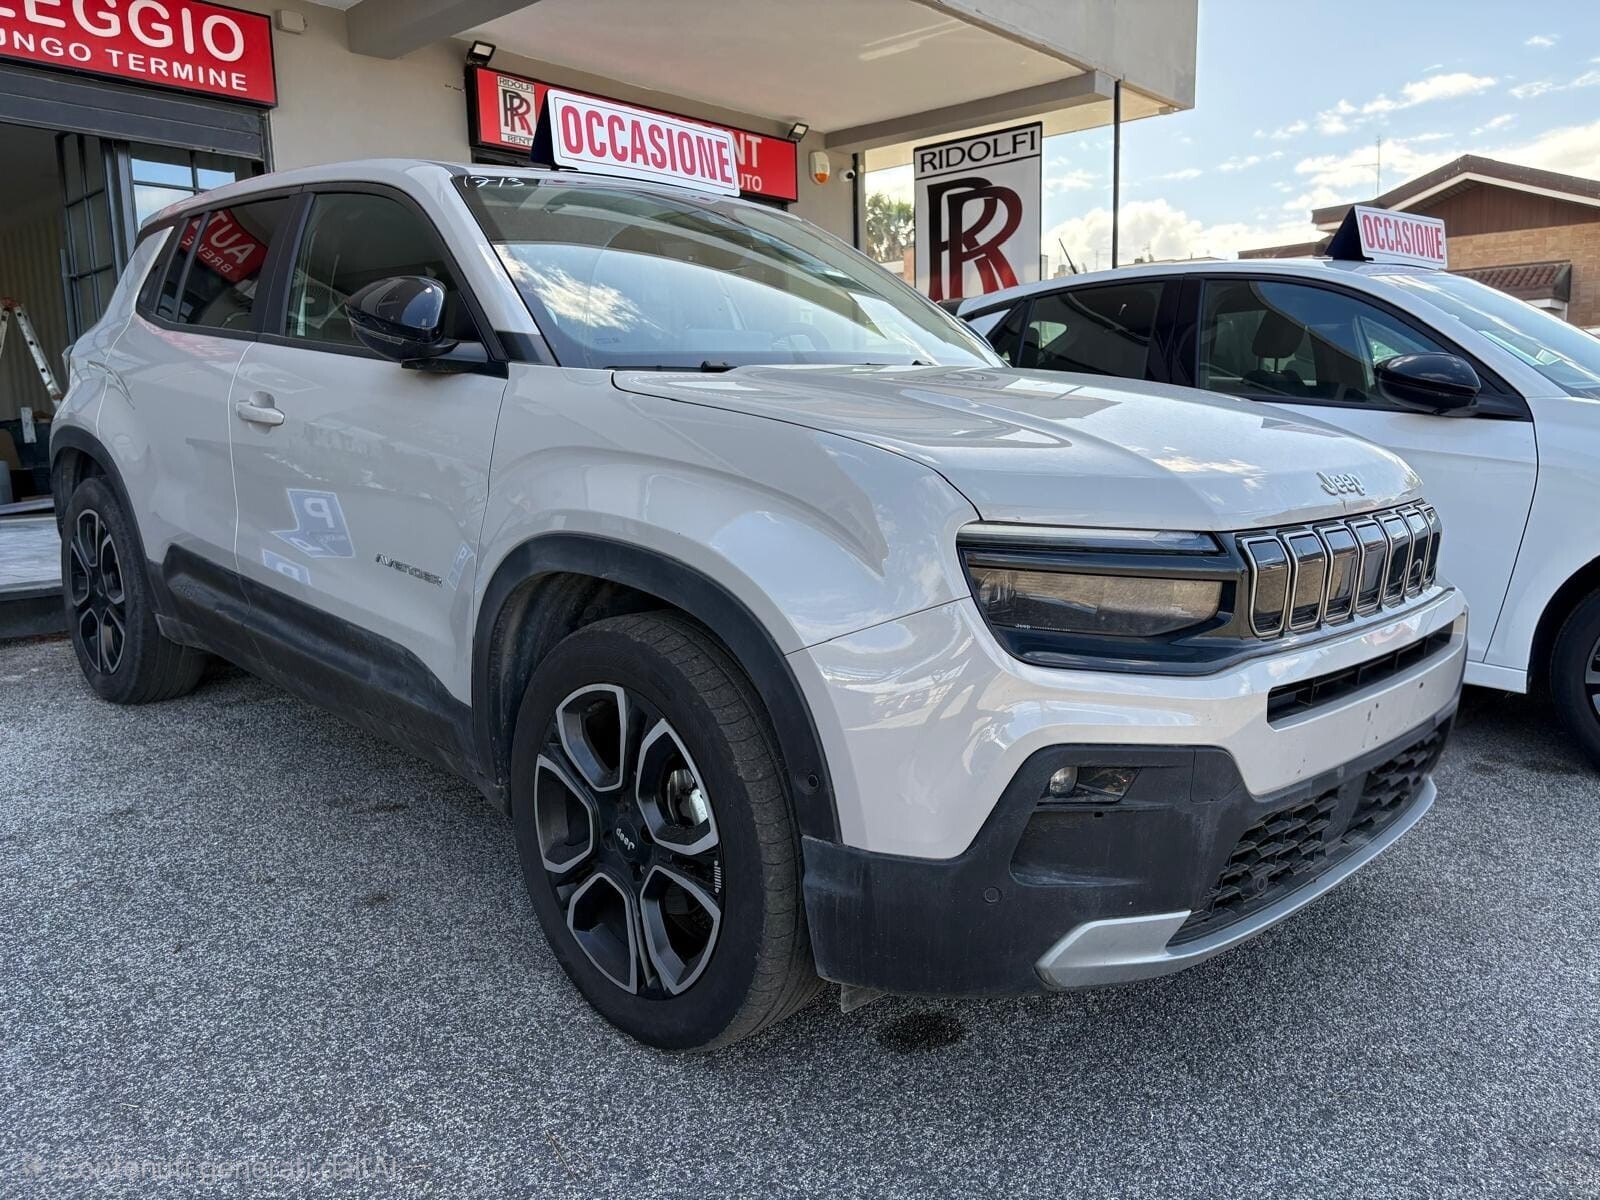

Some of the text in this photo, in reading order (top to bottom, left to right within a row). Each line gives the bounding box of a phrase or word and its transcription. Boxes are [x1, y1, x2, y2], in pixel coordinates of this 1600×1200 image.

[0, 0, 245, 62] EGGIO
[105, 48, 248, 92] TERMINE
[499, 78, 534, 92] RIDOLFI
[508, 135, 531, 145] RENT
[561, 105, 733, 184] OCCASIONE
[920, 130, 1036, 173] RIDOLFI
[1362, 214, 1444, 260] OCCASIONE
[1316, 471, 1366, 496] Jeep
